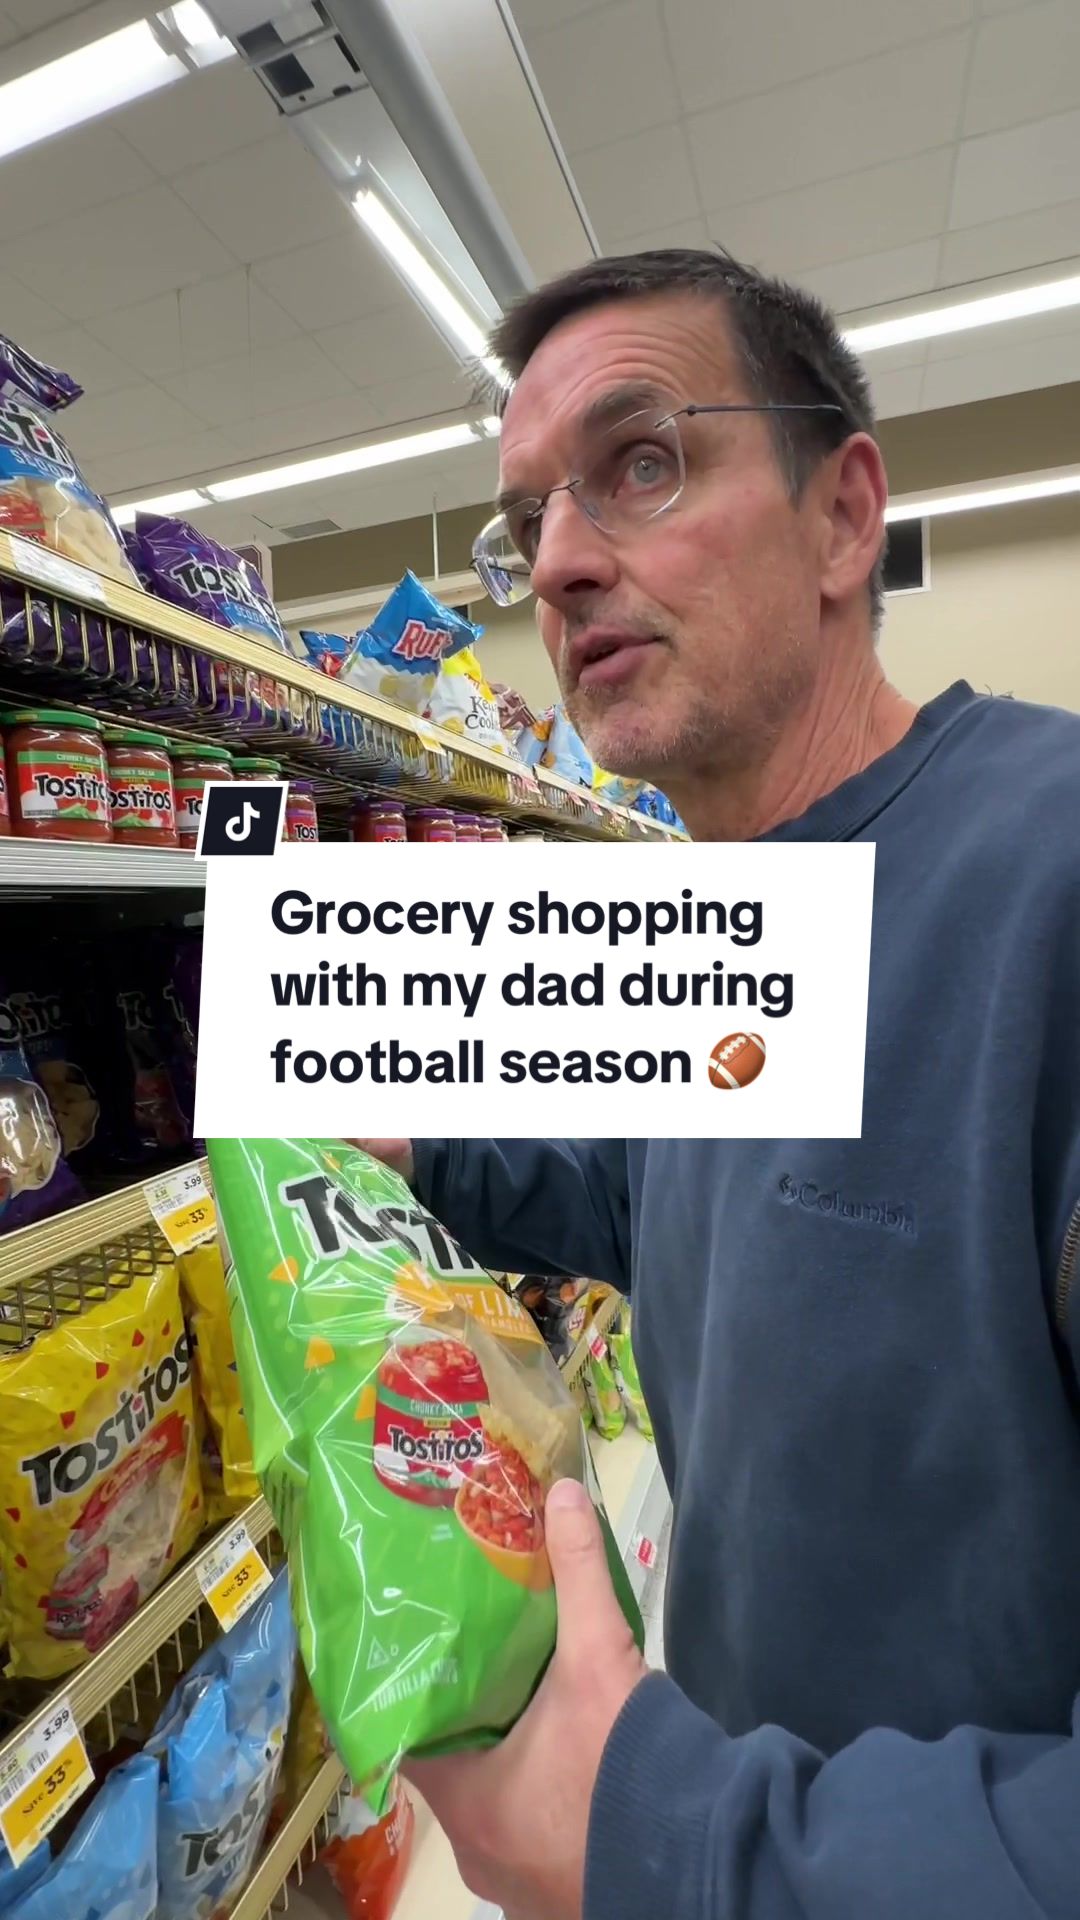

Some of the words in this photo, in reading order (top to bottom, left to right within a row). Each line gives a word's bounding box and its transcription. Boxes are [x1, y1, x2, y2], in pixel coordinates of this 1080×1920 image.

[184, 1176, 202, 1190] 3.99
[800, 1182, 915, 1233] Columbia
[389, 1426, 483, 1461] TOSTITOS
[229, 1529, 246, 1550] 3.99
[43, 1709, 69, 1741] 3.99
